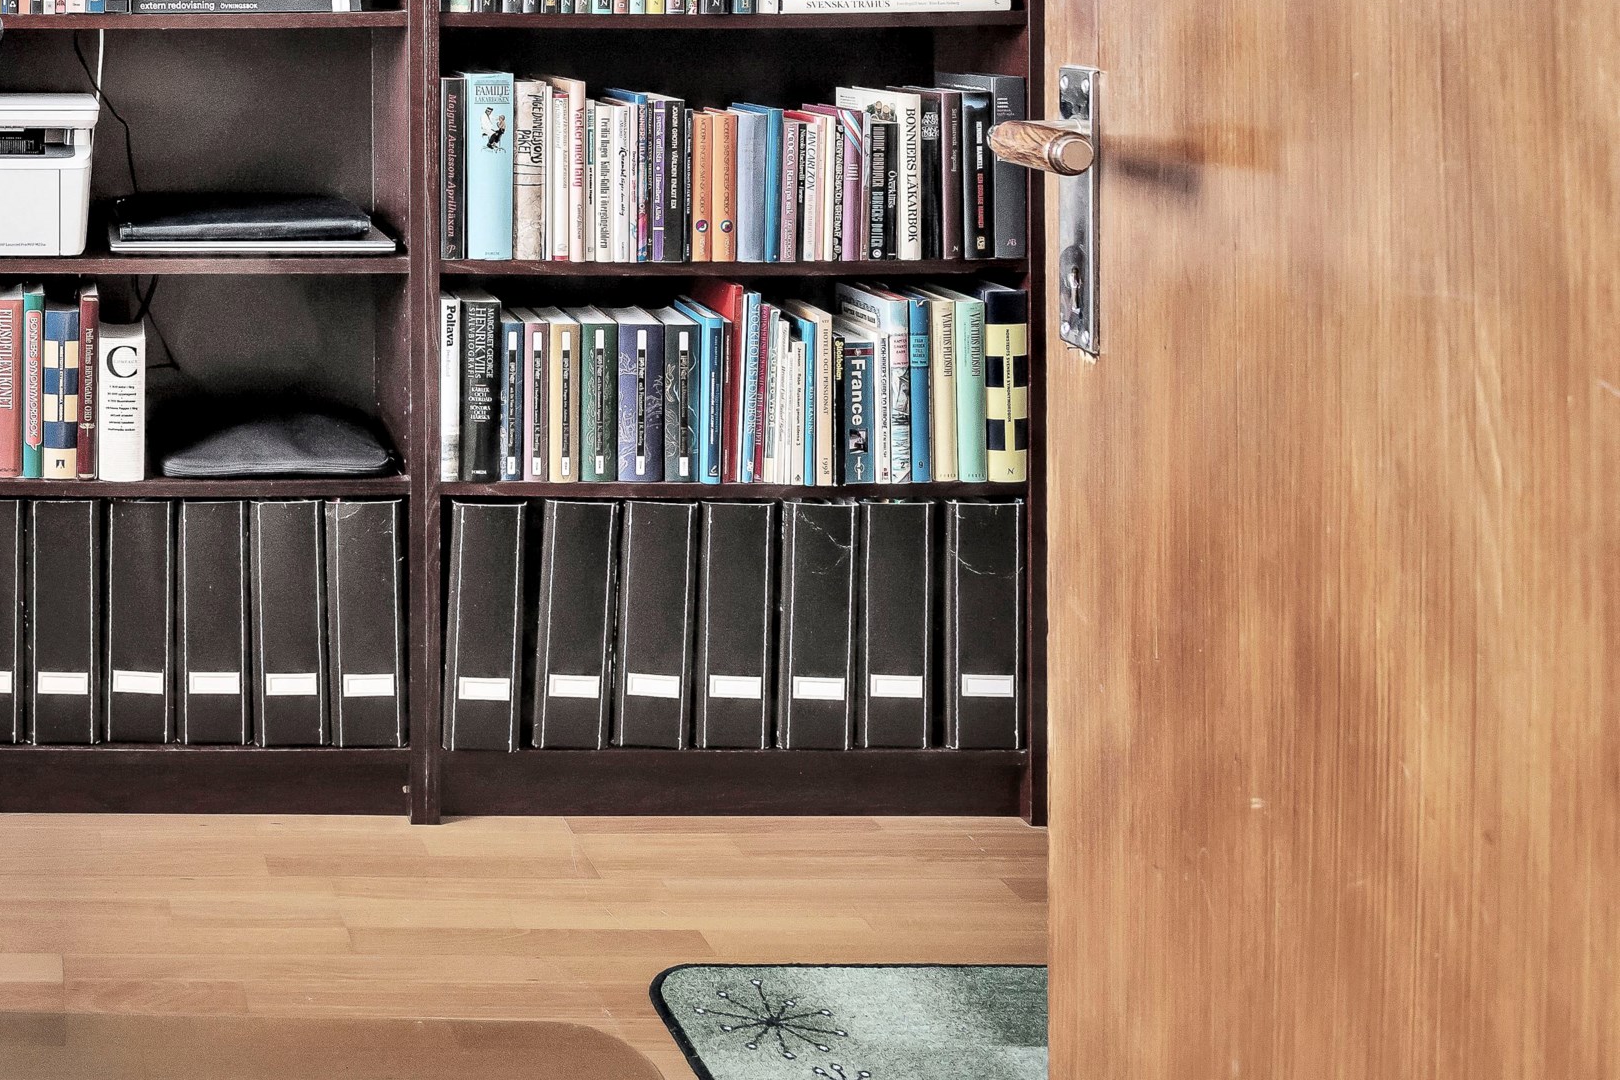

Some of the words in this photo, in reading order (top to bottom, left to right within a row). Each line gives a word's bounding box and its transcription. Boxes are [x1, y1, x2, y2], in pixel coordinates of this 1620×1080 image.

[140, 2, 166, 10] extern
[168, 1, 215, 11] redovisning
[447, 94, 456, 132] Majgull
[574, 107, 584, 140] Vacker
[448, 135, 456, 179] Axelsson
[518, 129, 531, 156] PAKET
[575, 142, 584, 165] med
[786, 127, 794, 166] IACOCCA
[906, 108, 918, 171] BONNIERS
[573, 168, 584, 188] färg
[784, 190, 794, 200] på
[786, 169, 794, 189] Rakt
[447, 181, 456, 237] Aprilhäxan
[907, 174, 919, 243] LÄKARBOK
[29, 317, 38, 358] BONNIERS
[86, 328, 94, 343] Pelle
[446, 305, 456, 347] Poltava
[468, 307, 476, 378] SJÄLVBIOGRAFI
[475, 308, 486, 353] HENRIK
[486, 308, 494, 348] MARGARET
[85, 344, 94, 364] Holms
[106, 345, 137, 378] C
[835, 341, 843, 380] Stickboken
[943, 346, 952, 377] FILOSOFI
[971, 346, 981, 377] FILOSOFI
[29, 360, 37, 438] SYNONYMORDBOK
[84, 365, 92, 404] BEVINGADE
[852, 359, 865, 426] France
[84, 405, 92, 421] ORD
